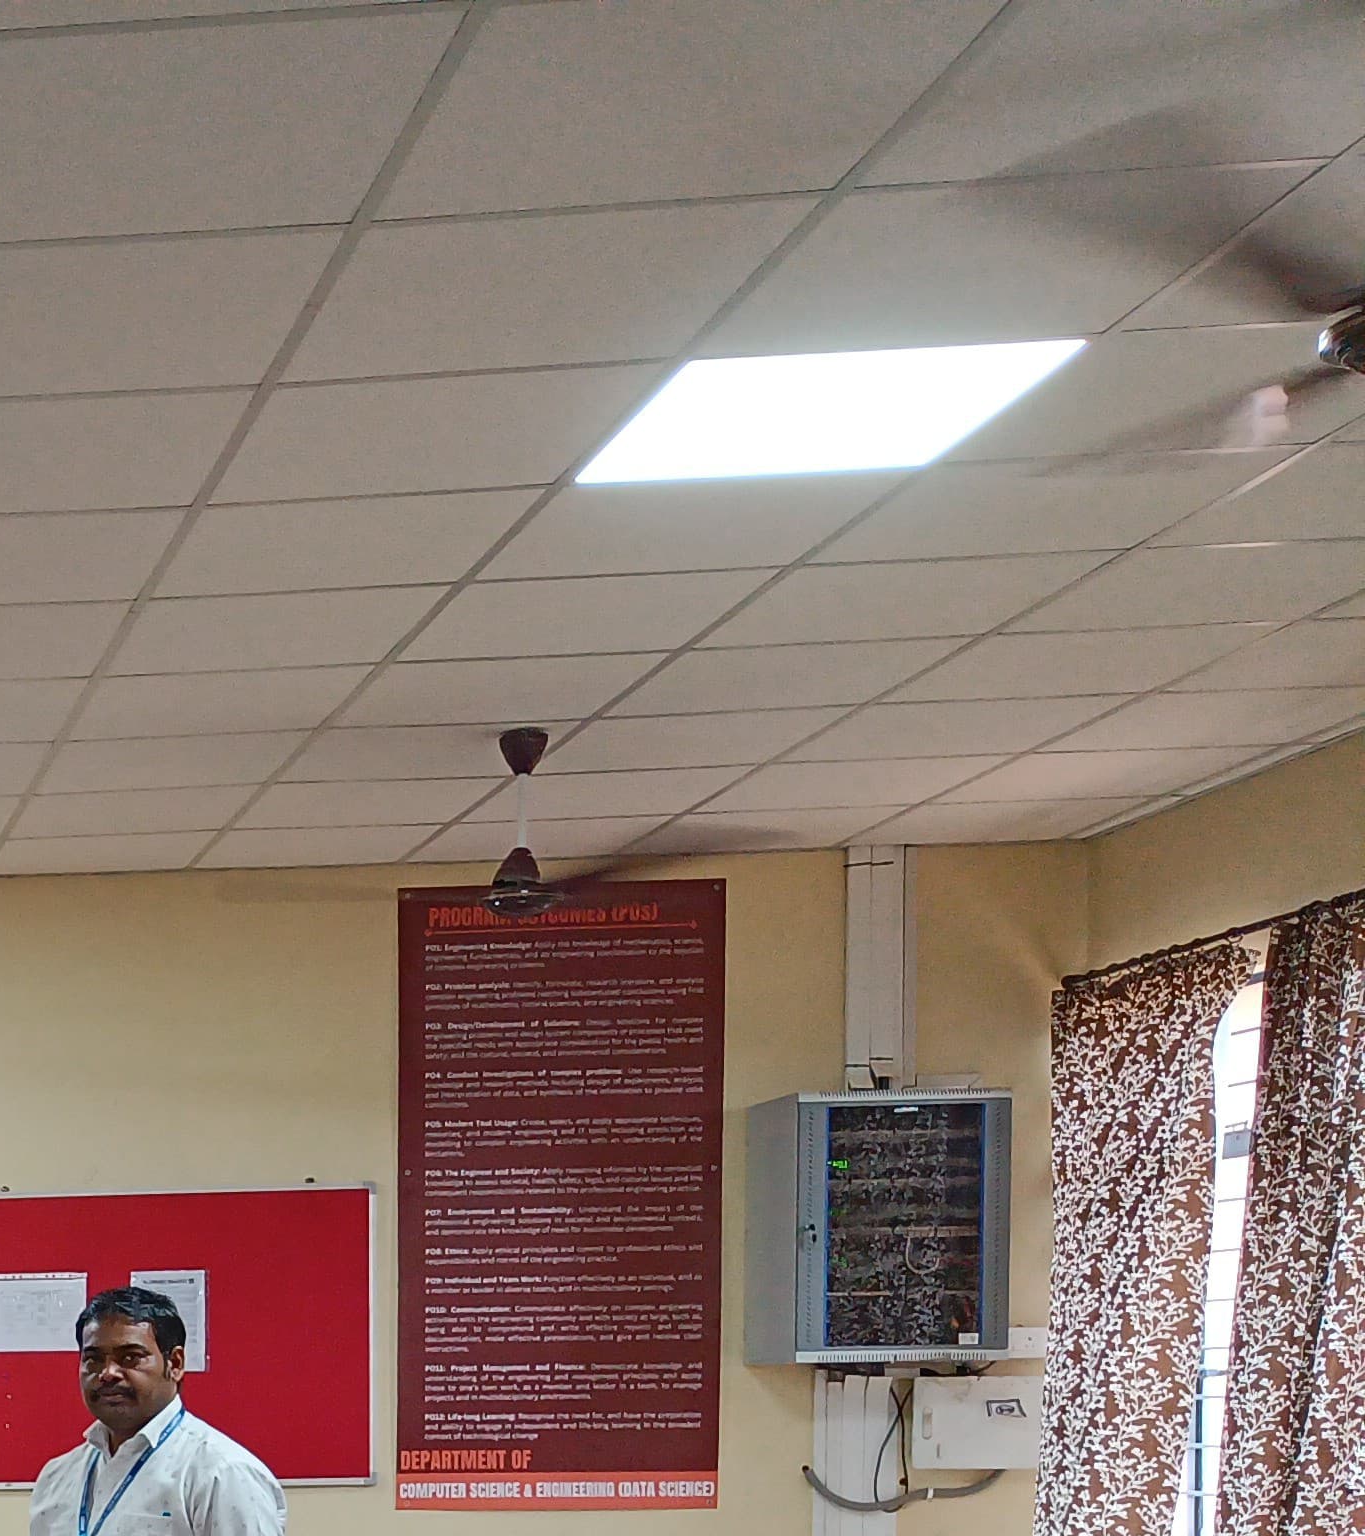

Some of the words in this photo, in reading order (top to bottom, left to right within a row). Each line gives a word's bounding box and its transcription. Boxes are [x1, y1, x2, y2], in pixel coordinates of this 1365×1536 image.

[400, 1450, 509, 1470] DEPARTMENT
[512, 1449, 533, 1470] OF
[399, 1483, 466, 1499] COMPUTER
[469, 1482, 521, 1498] SCIENCE
[536, 1481, 615, 1498] ENGINEERING
[618, 1481, 656, 1498] (DATA
[658, 1480, 715, 1498] SCIENCE)
